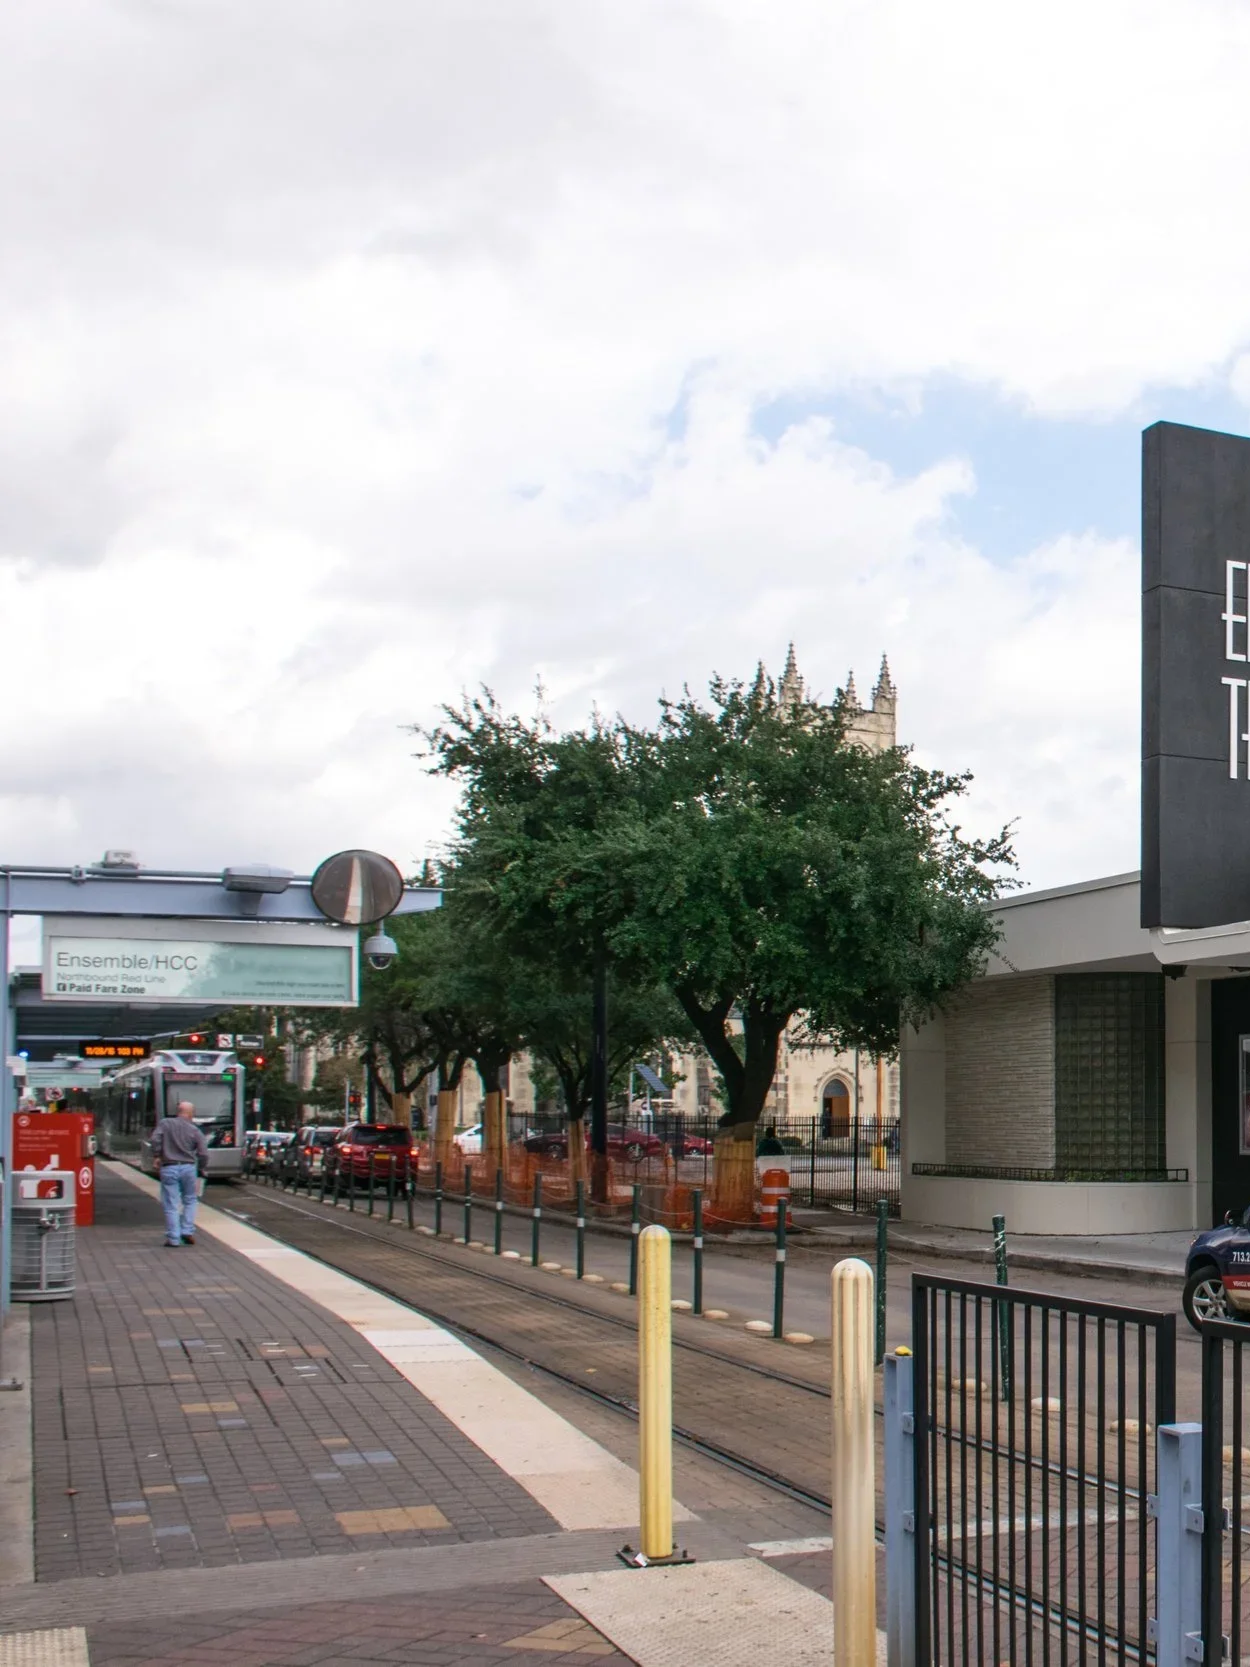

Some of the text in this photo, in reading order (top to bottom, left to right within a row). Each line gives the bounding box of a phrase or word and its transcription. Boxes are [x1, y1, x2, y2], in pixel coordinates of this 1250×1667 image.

[57, 952, 198, 971] Ensemble/HCC
[57, 972, 166, 984] Northbound Red Line
[69, 983, 146, 995] Paid Fare Zone
